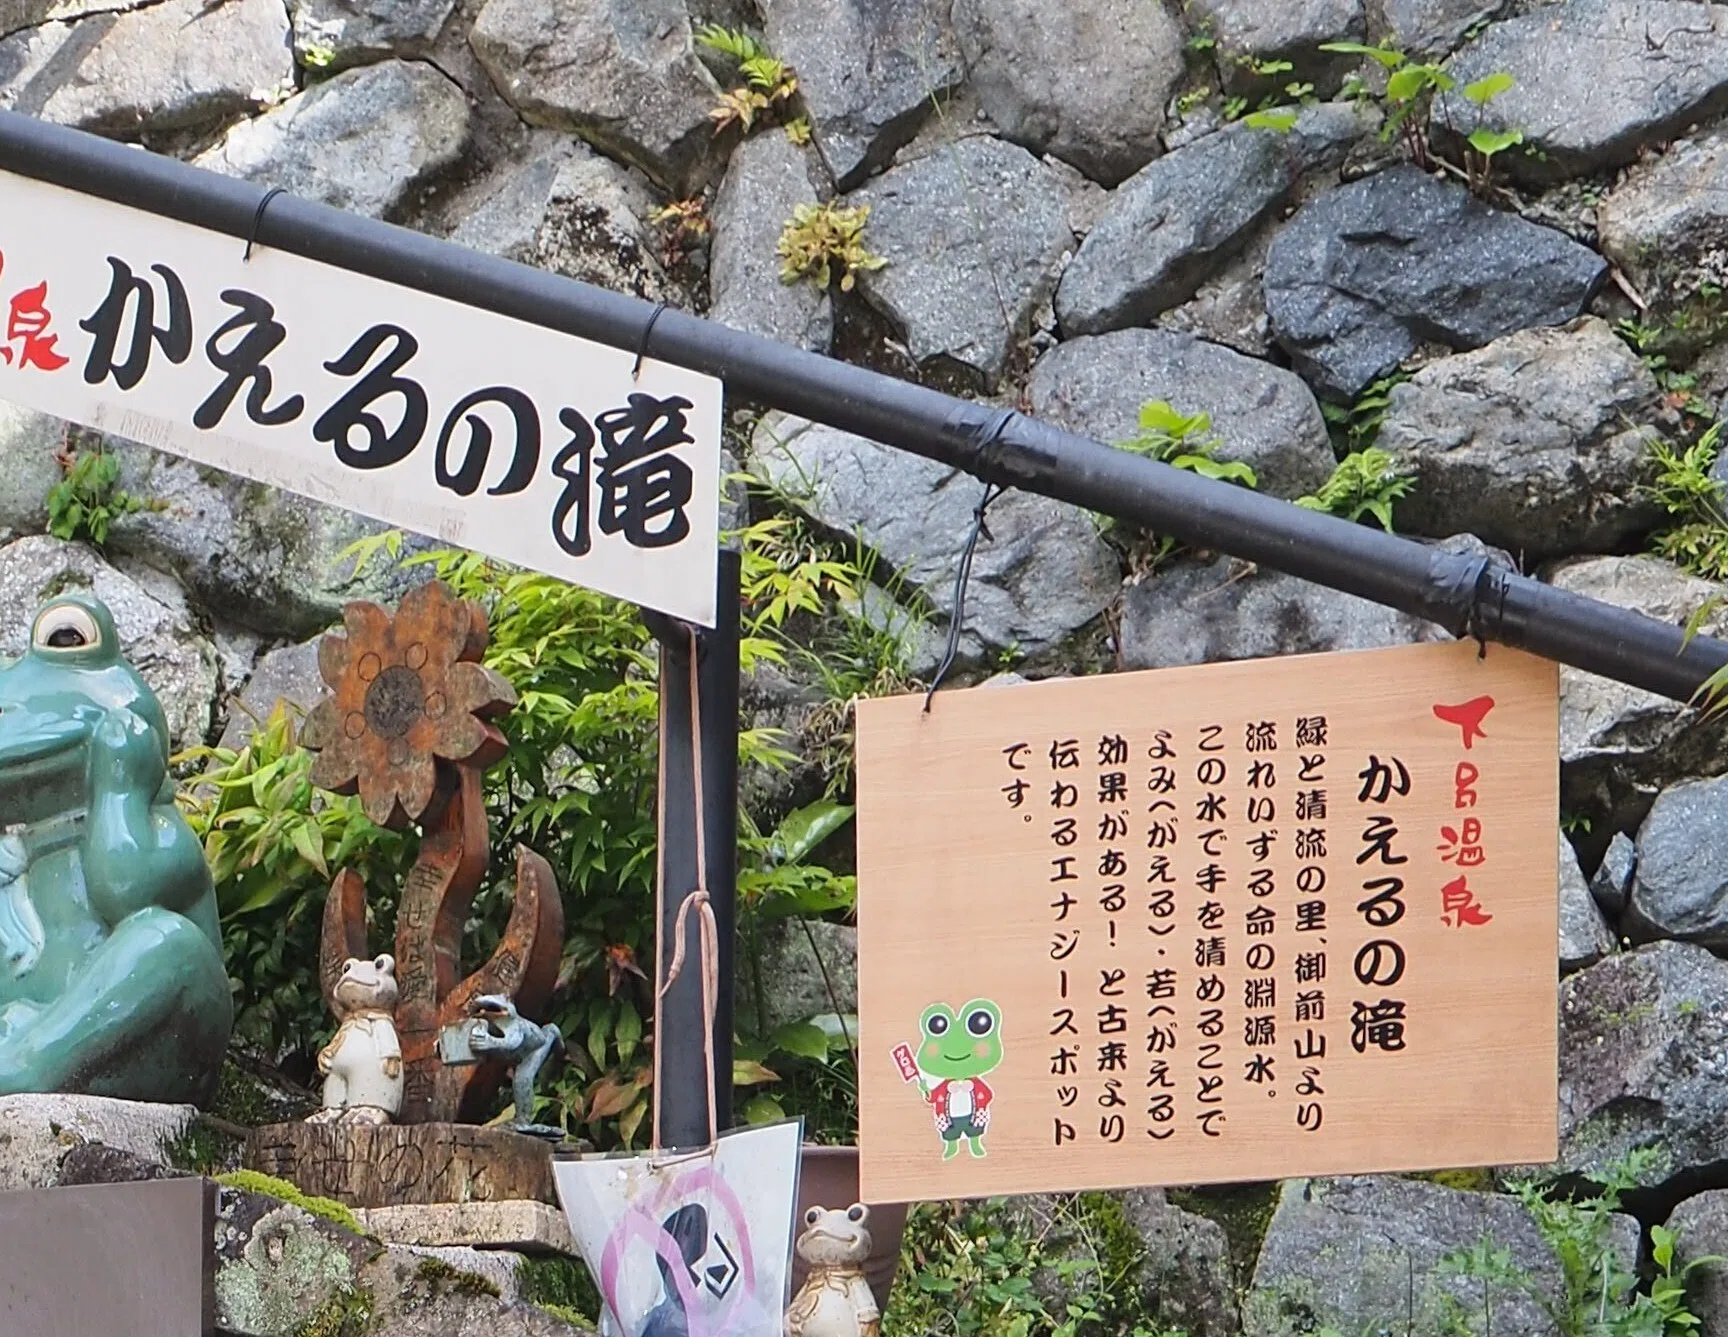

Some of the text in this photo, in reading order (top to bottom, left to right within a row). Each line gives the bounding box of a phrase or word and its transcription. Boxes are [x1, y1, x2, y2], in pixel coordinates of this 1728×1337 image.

[78, 256, 696, 557] かえるの滝
[1002, 743, 1032, 823] です。
[1050, 740, 1079, 1146] 伝わるエナジースポット
[1196, 726, 1226, 1137] この水で手を清めることで
[1245, 721, 1278, 1099] 流れいずる命の淵源水。
[1295, 716, 1327, 1131] 緑と清流の里、御前山より
[1350, 755, 1411, 1054] かえるの滝
[1433, 696, 1495, 927] 下呂温泉
